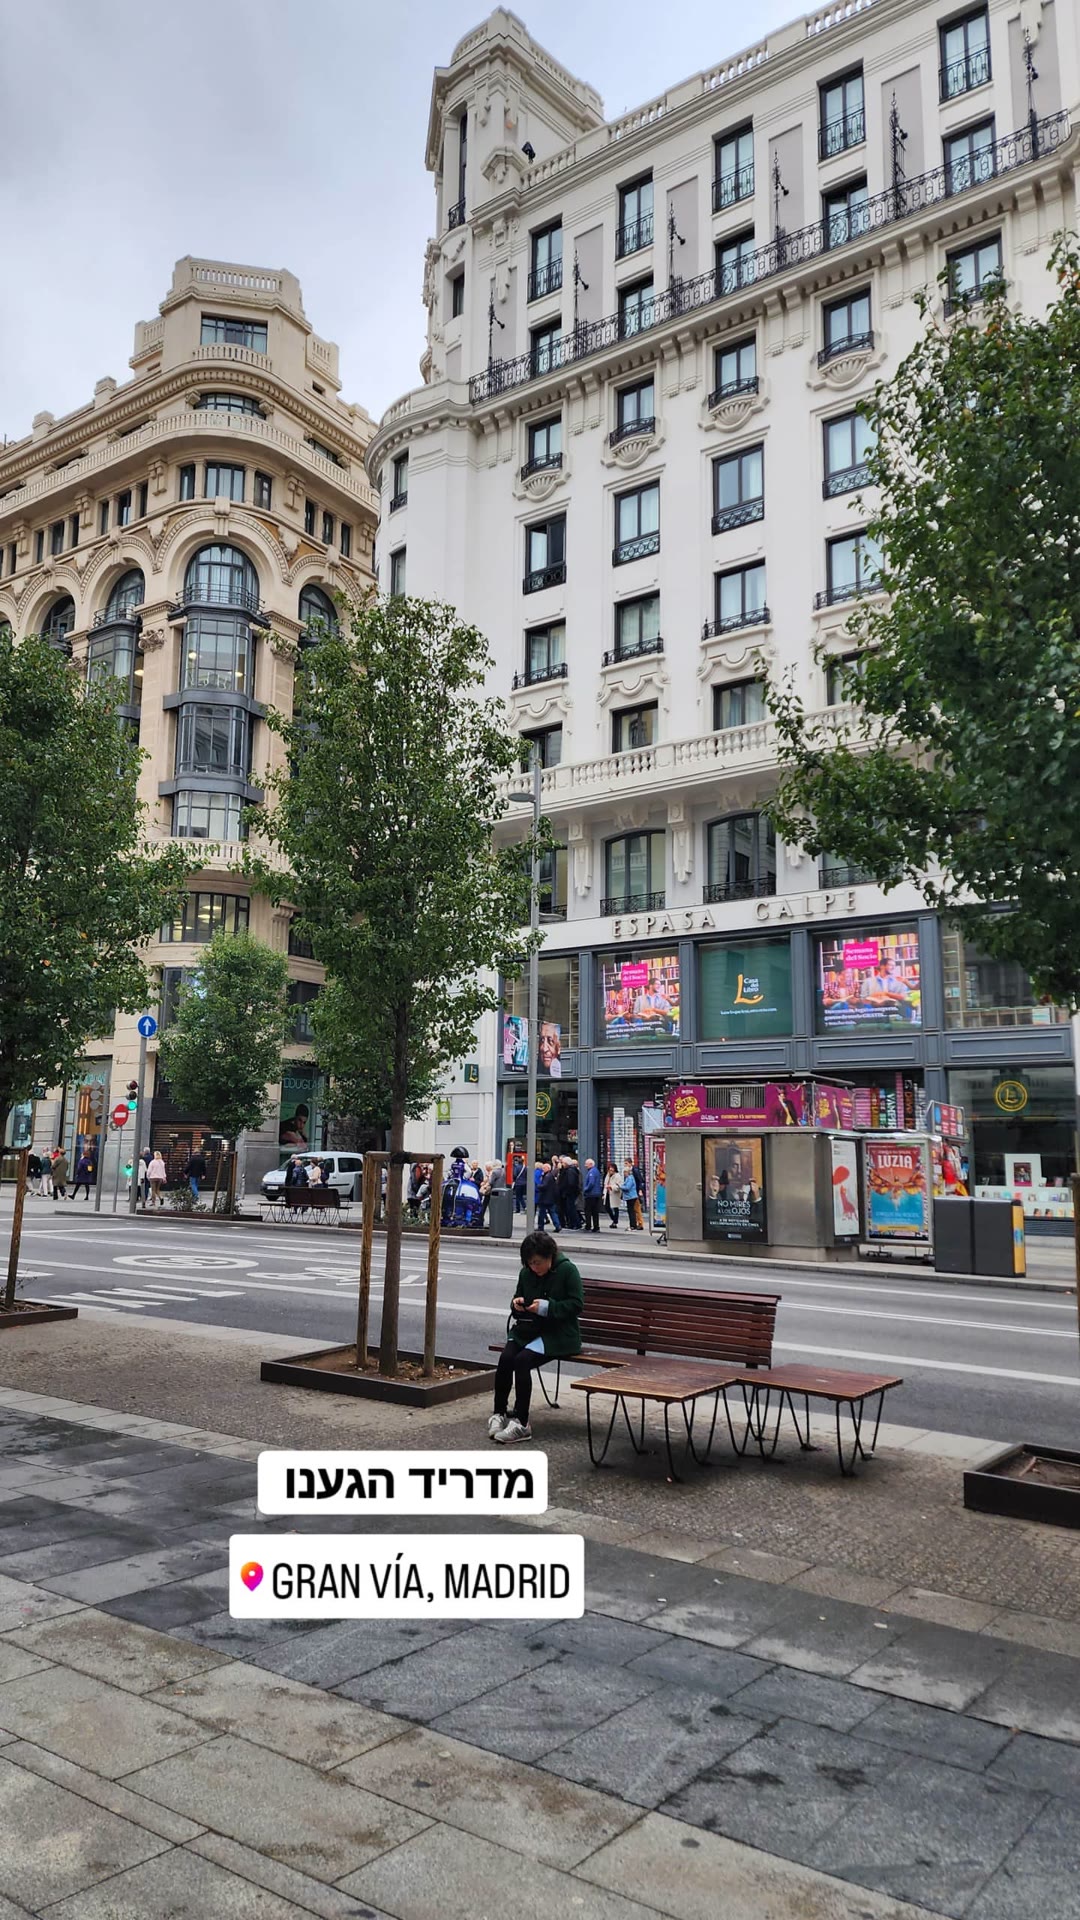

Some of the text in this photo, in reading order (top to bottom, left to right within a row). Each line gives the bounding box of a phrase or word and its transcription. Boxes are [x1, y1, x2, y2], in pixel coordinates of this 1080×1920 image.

[612, 890, 857, 938] ESPASA CALPE
[877, 1154, 913, 1169] LUZIA
[730, 1200, 751, 1208] MIRES
[731, 1207, 751, 1215] OJOS
